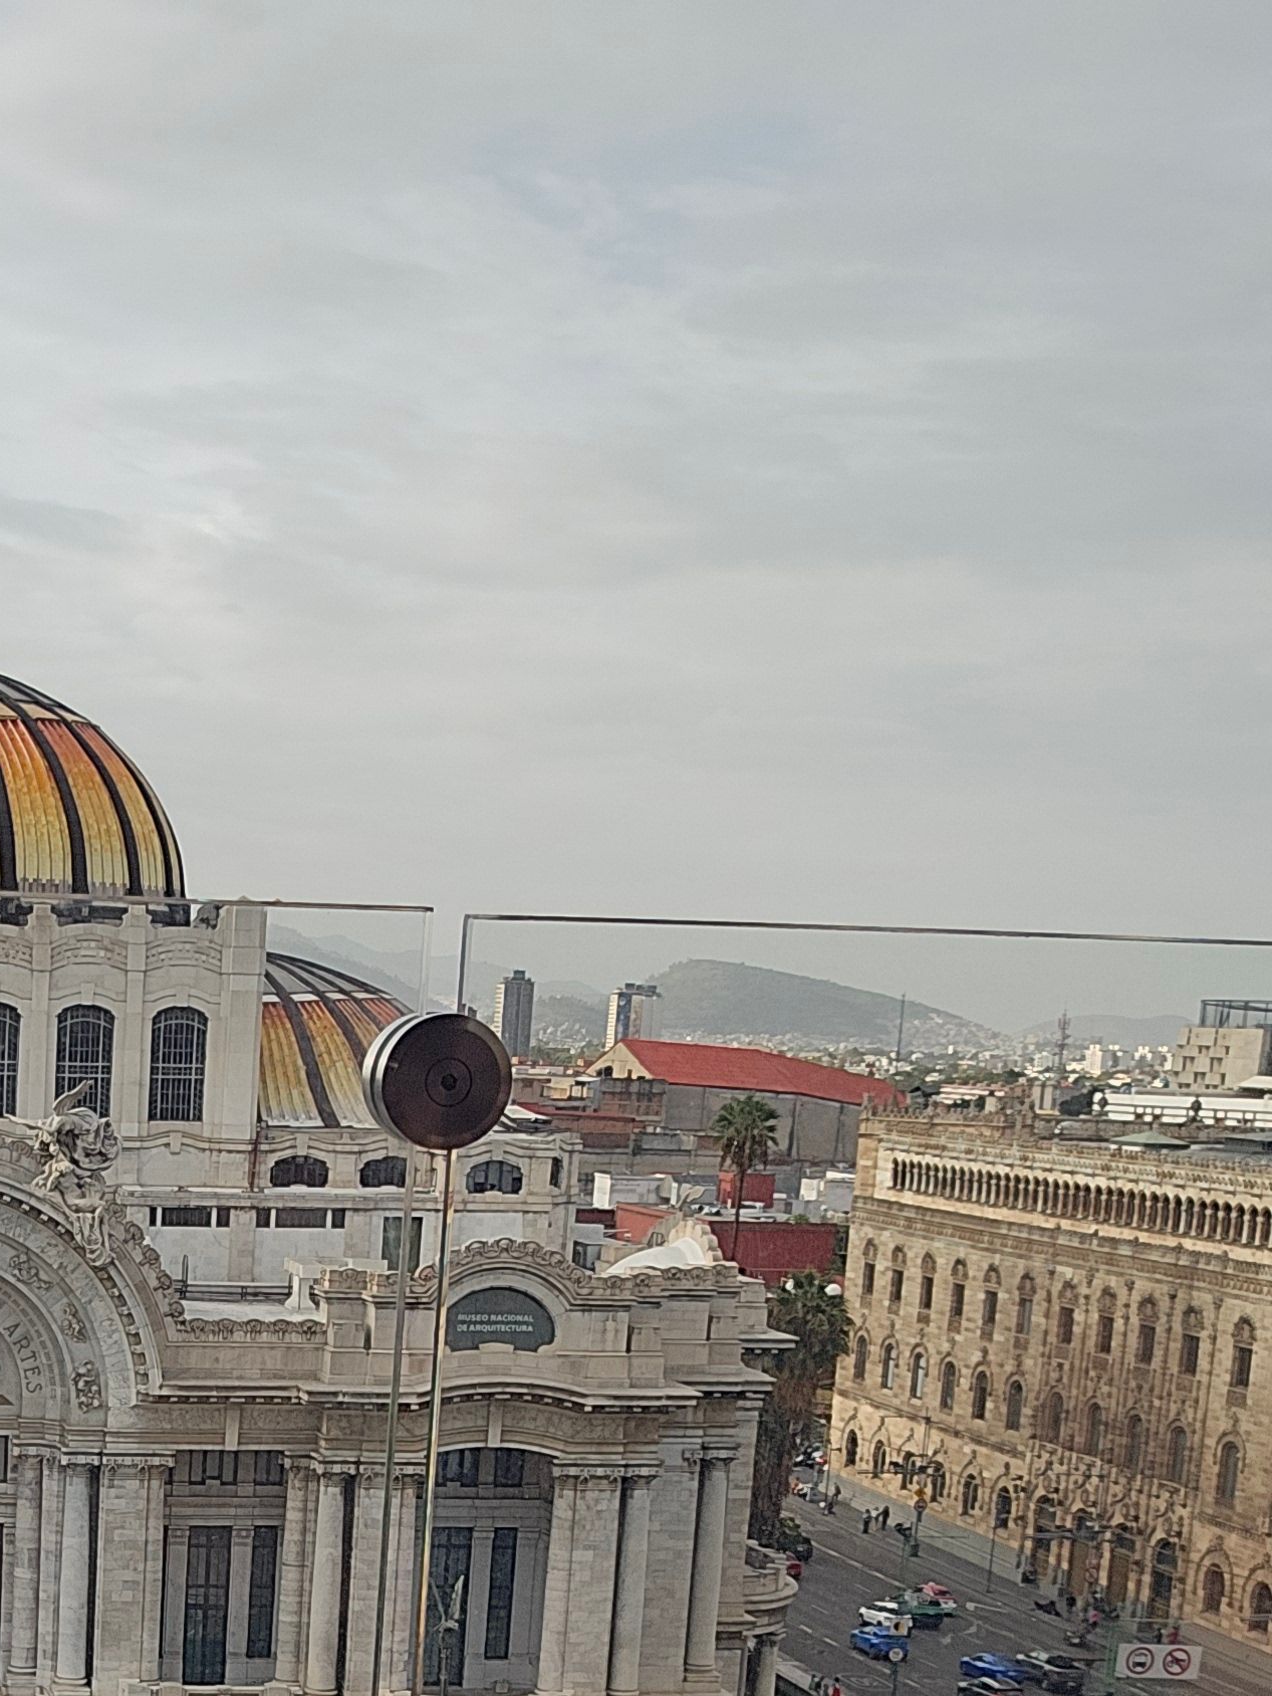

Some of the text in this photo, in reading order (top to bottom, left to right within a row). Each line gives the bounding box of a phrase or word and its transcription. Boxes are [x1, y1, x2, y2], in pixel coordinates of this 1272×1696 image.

[457, 1313, 534, 1322] MUSEO NACIONAL
[456, 1323, 534, 1333] DE ARQUITECTURA
[2, 1321, 43, 1394] ARTES
